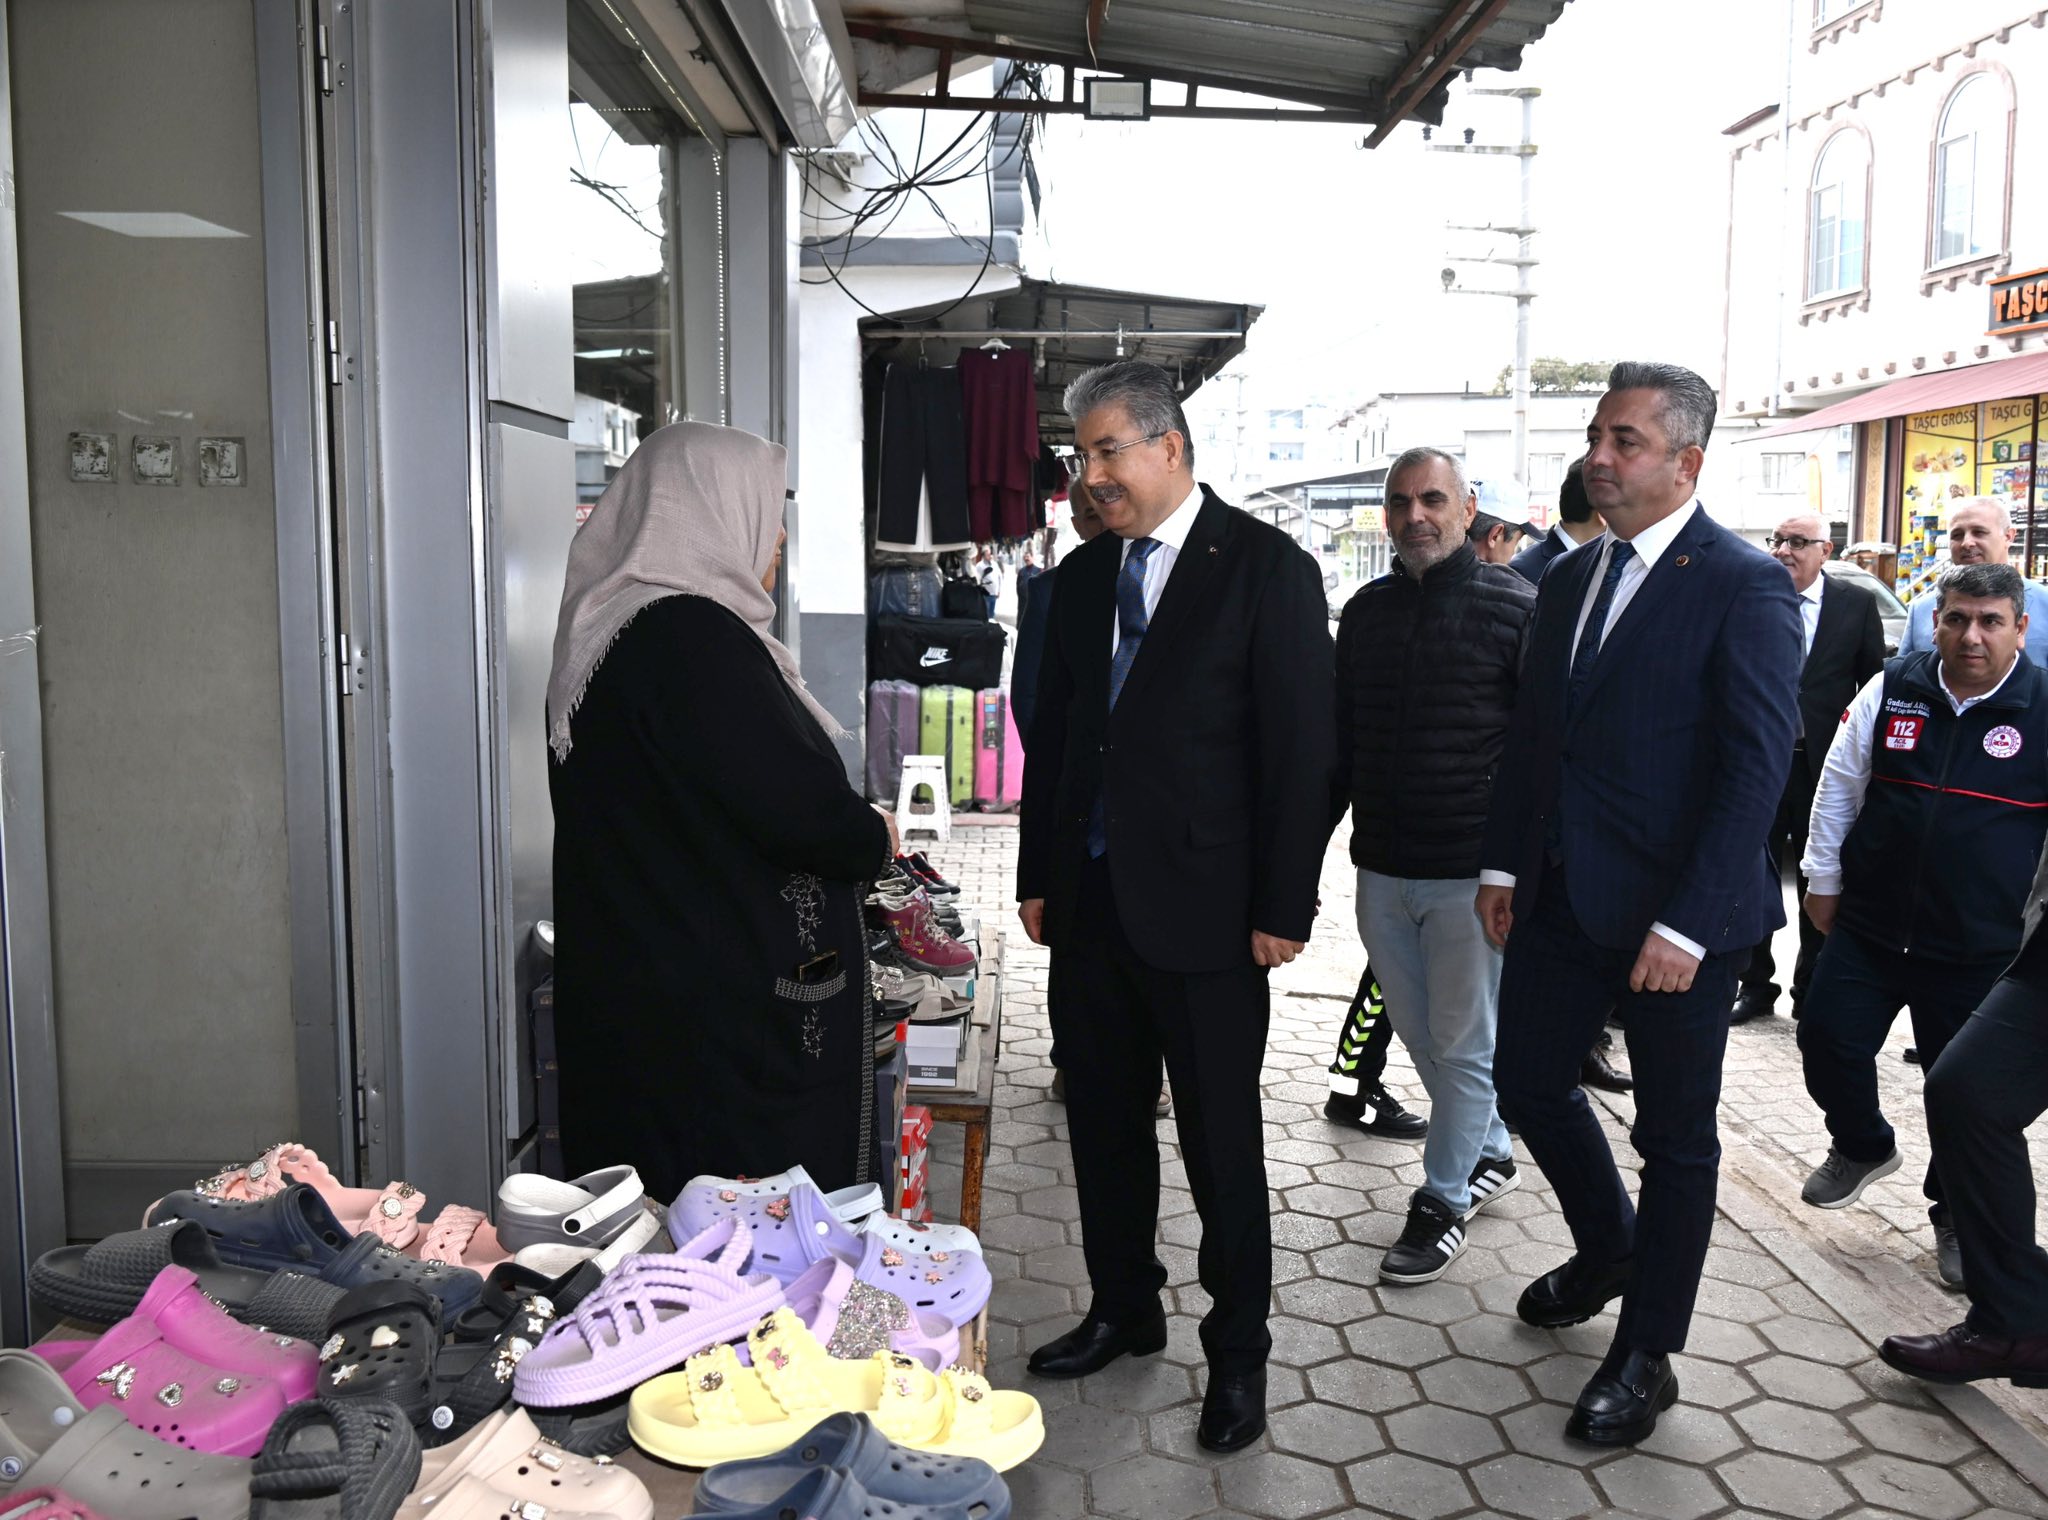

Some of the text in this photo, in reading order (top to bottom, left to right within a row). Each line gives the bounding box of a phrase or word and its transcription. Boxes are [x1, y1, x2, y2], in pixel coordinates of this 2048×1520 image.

[1913, 409, 1976, 431] TAŞCI GROSS
[1991, 404, 2020, 422] TAŞCI
[925, 646, 949, 660] NIKE
[1893, 720, 1915, 737] 112
